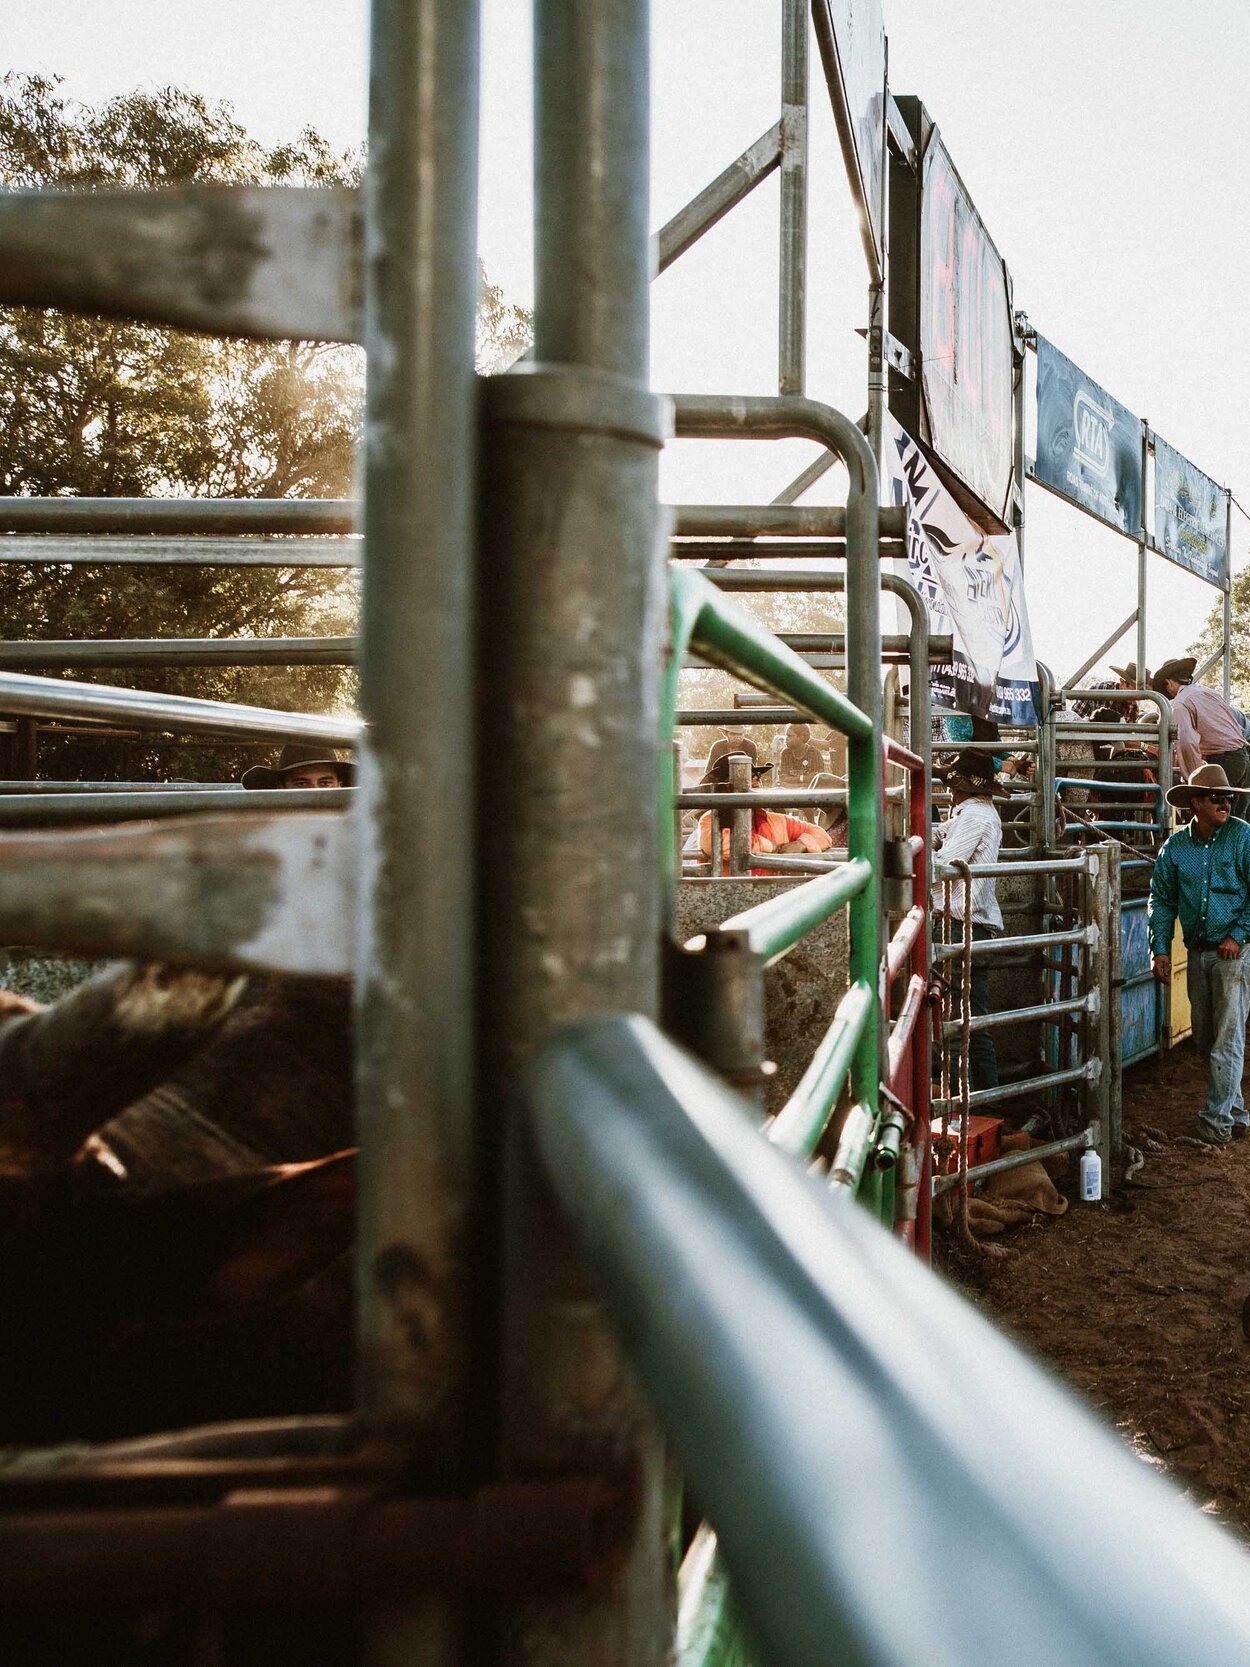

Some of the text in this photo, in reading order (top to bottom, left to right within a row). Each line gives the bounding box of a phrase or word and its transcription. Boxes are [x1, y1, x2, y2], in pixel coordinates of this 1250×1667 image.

[1081, 409, 1103, 460] RTA
[1003, 686, 1014, 701] 965
[1014, 688, 1032, 702] 332
